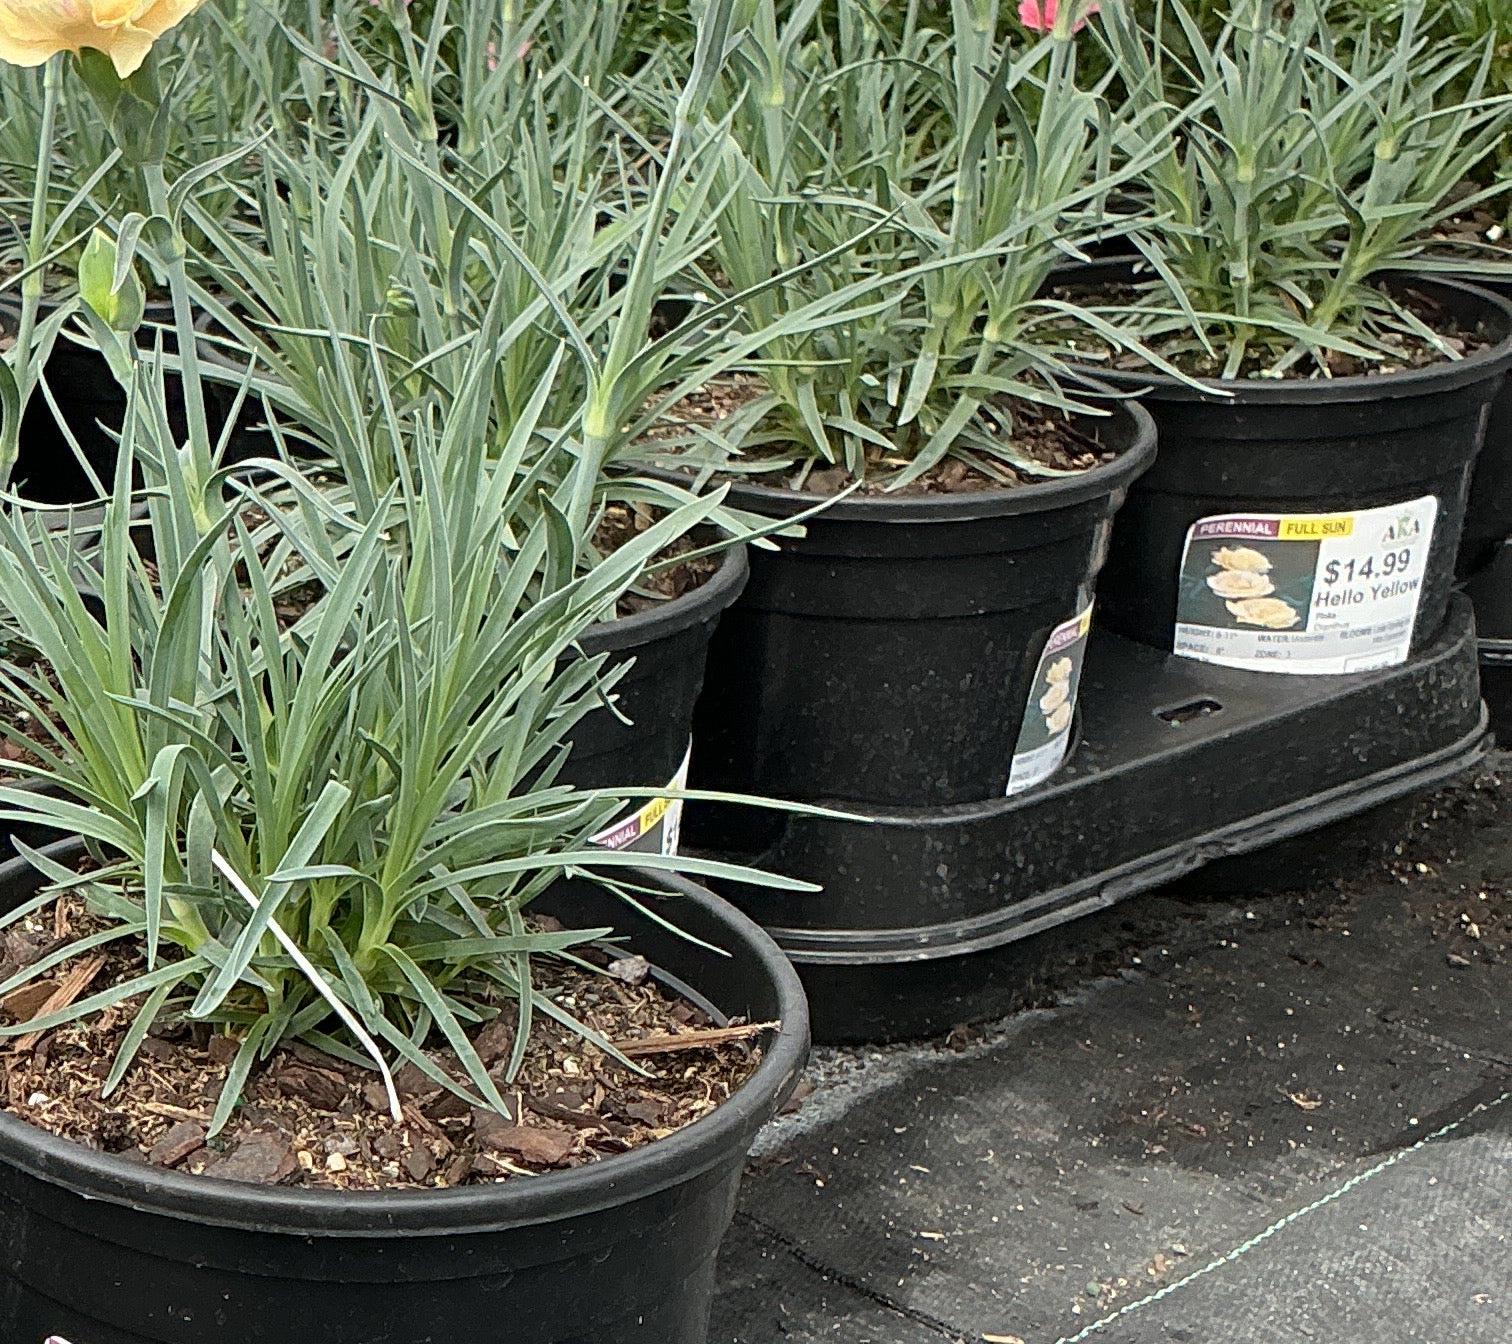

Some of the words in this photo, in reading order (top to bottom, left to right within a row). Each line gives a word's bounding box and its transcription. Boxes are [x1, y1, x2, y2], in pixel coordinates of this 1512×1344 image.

[1199, 522, 1274, 535] PERENNIAL
[1286, 522, 1319, 536] FULL
[1321, 520, 1347, 535] SUN
[1323, 548, 1412, 587] $14.99
[1315, 590, 1365, 608] Hello
[1371, 577, 1421, 601] Yellow
